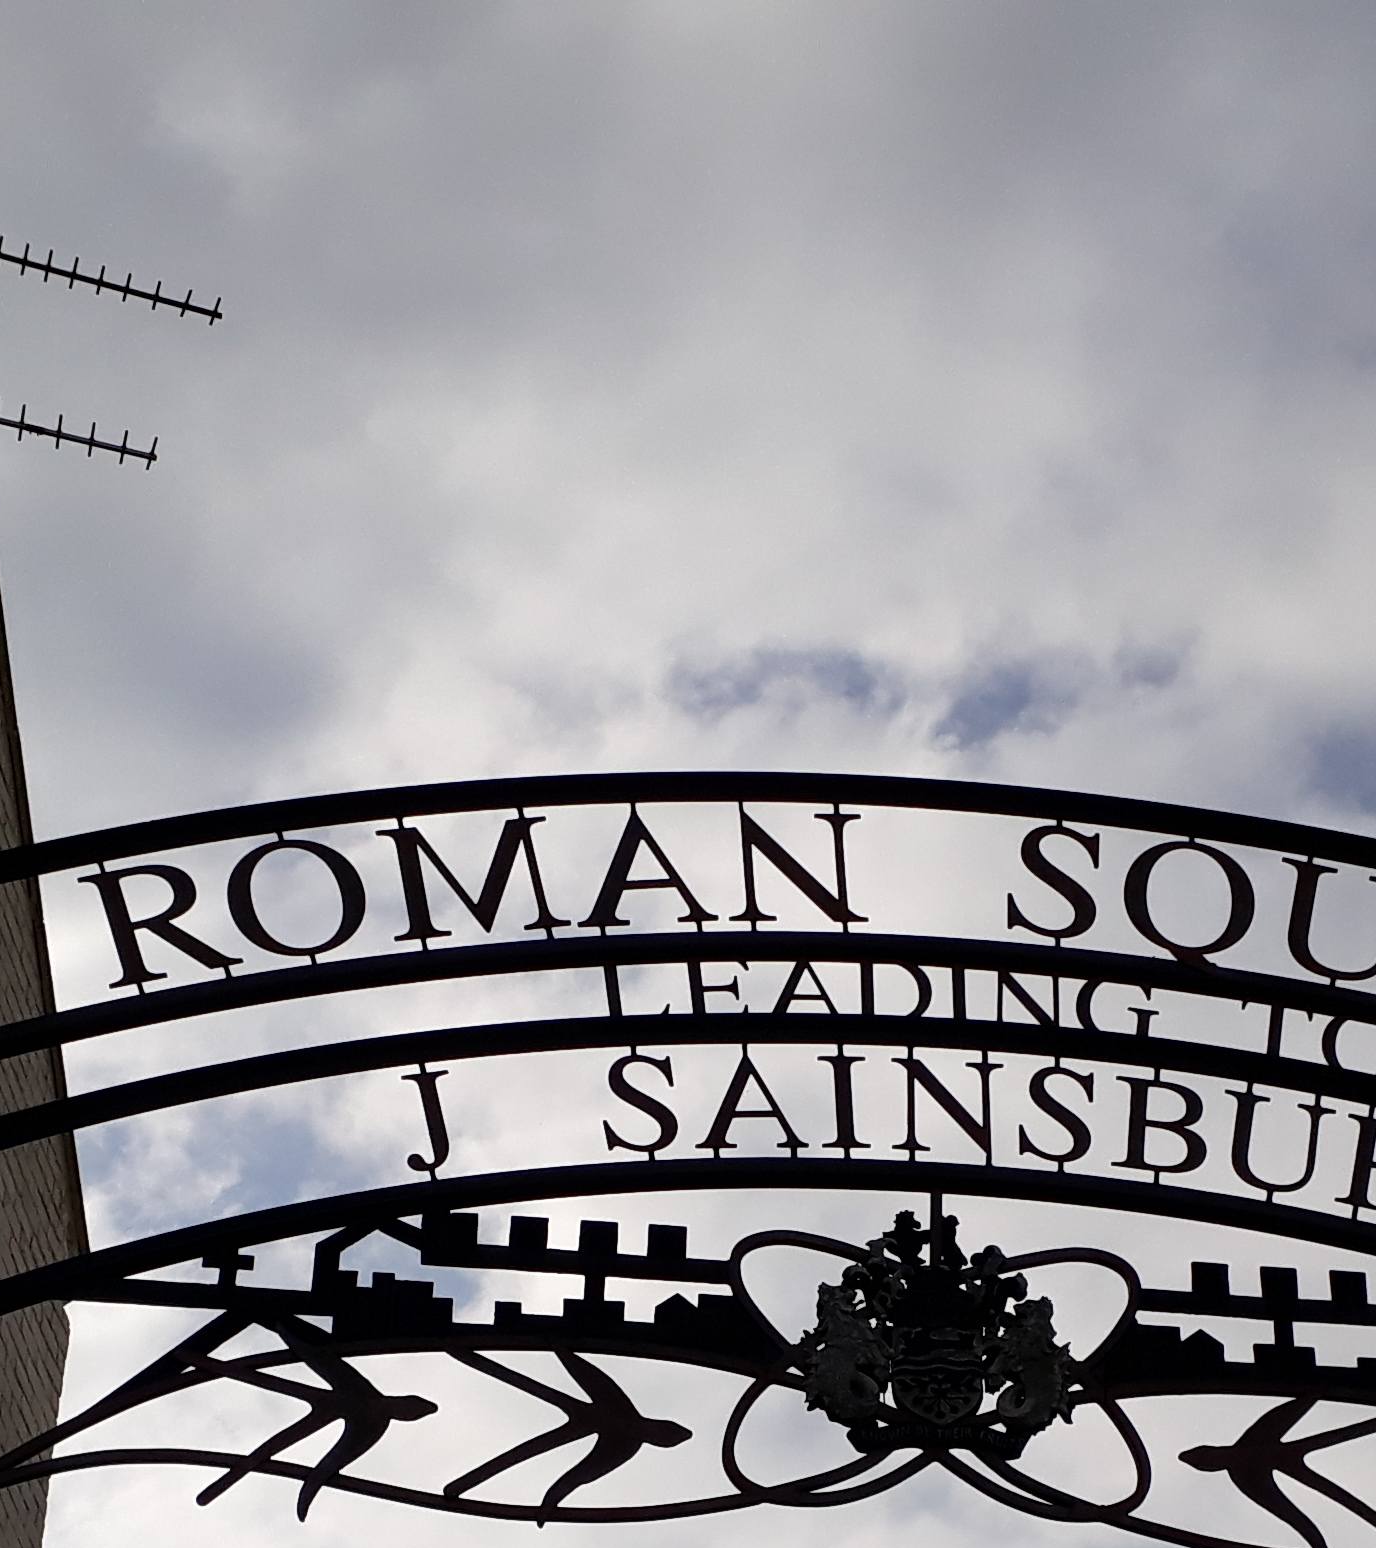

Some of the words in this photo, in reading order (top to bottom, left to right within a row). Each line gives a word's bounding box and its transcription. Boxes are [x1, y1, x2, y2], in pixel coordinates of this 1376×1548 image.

[79, 803, 868, 989] ROMAN
[600, 959, 1153, 1038] LEADING
[401, 1068, 450, 1174] J
